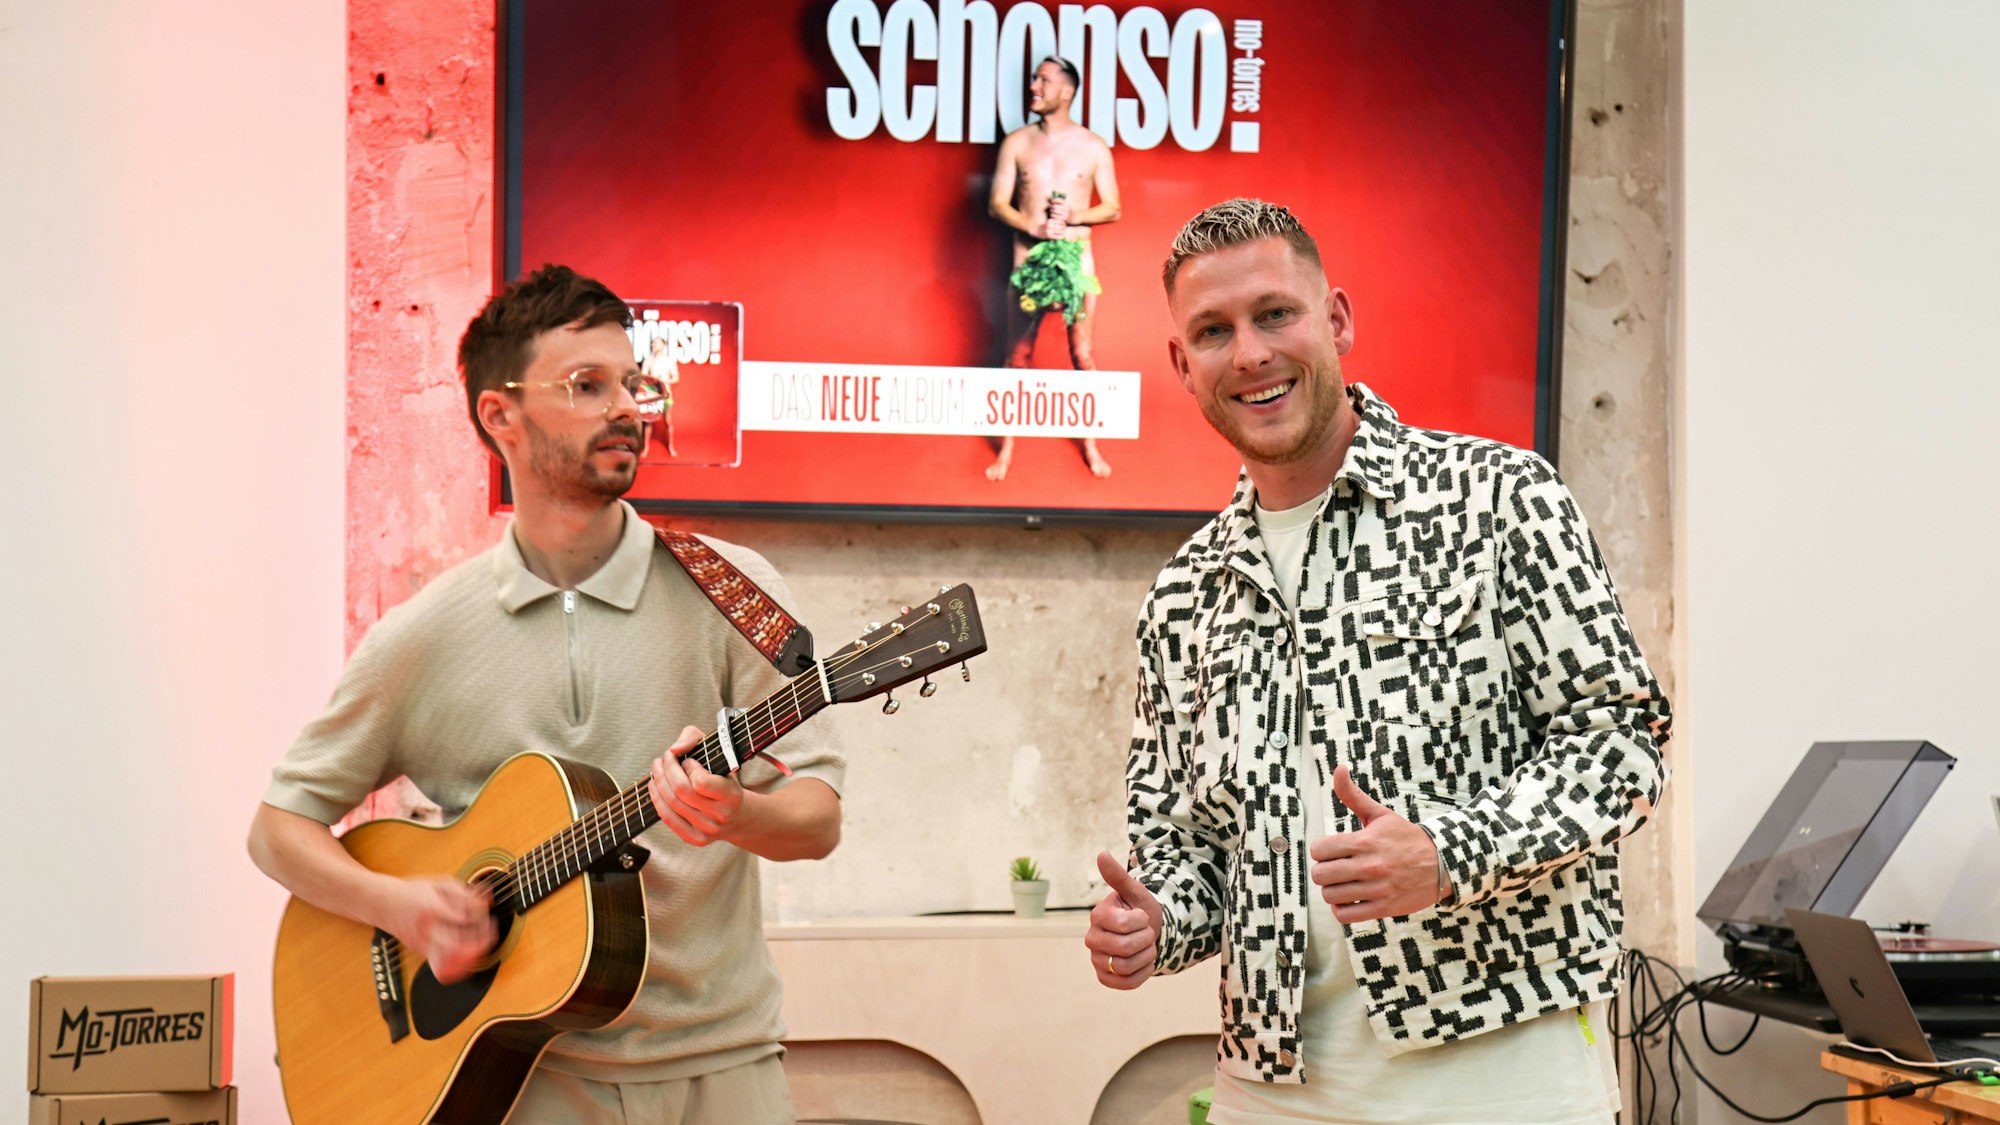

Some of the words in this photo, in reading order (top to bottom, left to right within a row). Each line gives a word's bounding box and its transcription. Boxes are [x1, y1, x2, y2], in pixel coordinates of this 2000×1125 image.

[1232, 19, 1265, 112] mo-torres
[771, 373, 813, 421] DAS
[821, 375, 881, 422] NEUE
[888, 377, 965, 424] ALBUM
